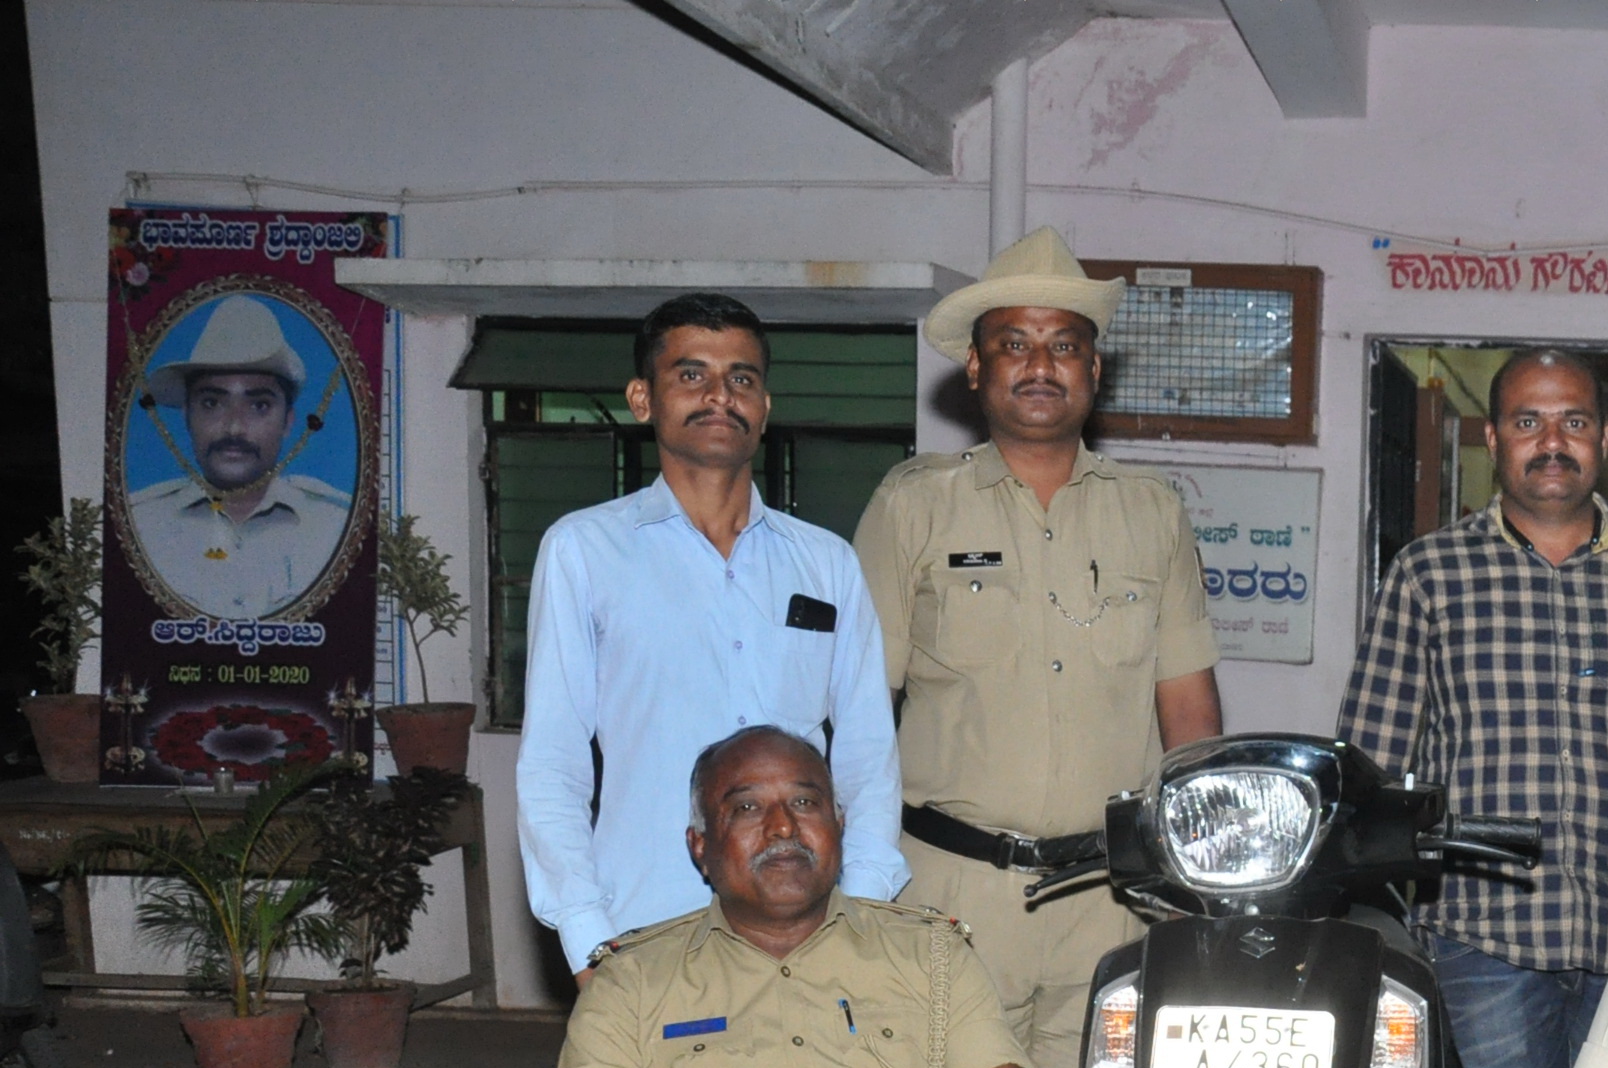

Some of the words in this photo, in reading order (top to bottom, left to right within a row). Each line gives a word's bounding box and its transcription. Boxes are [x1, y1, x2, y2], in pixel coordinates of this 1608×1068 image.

[140, 212, 260, 251] ಭಾವಪೂರ್ಣ
[217, 665, 310, 684] 01-01-2020
[1188, 1014, 1309, 1047] KA55E
